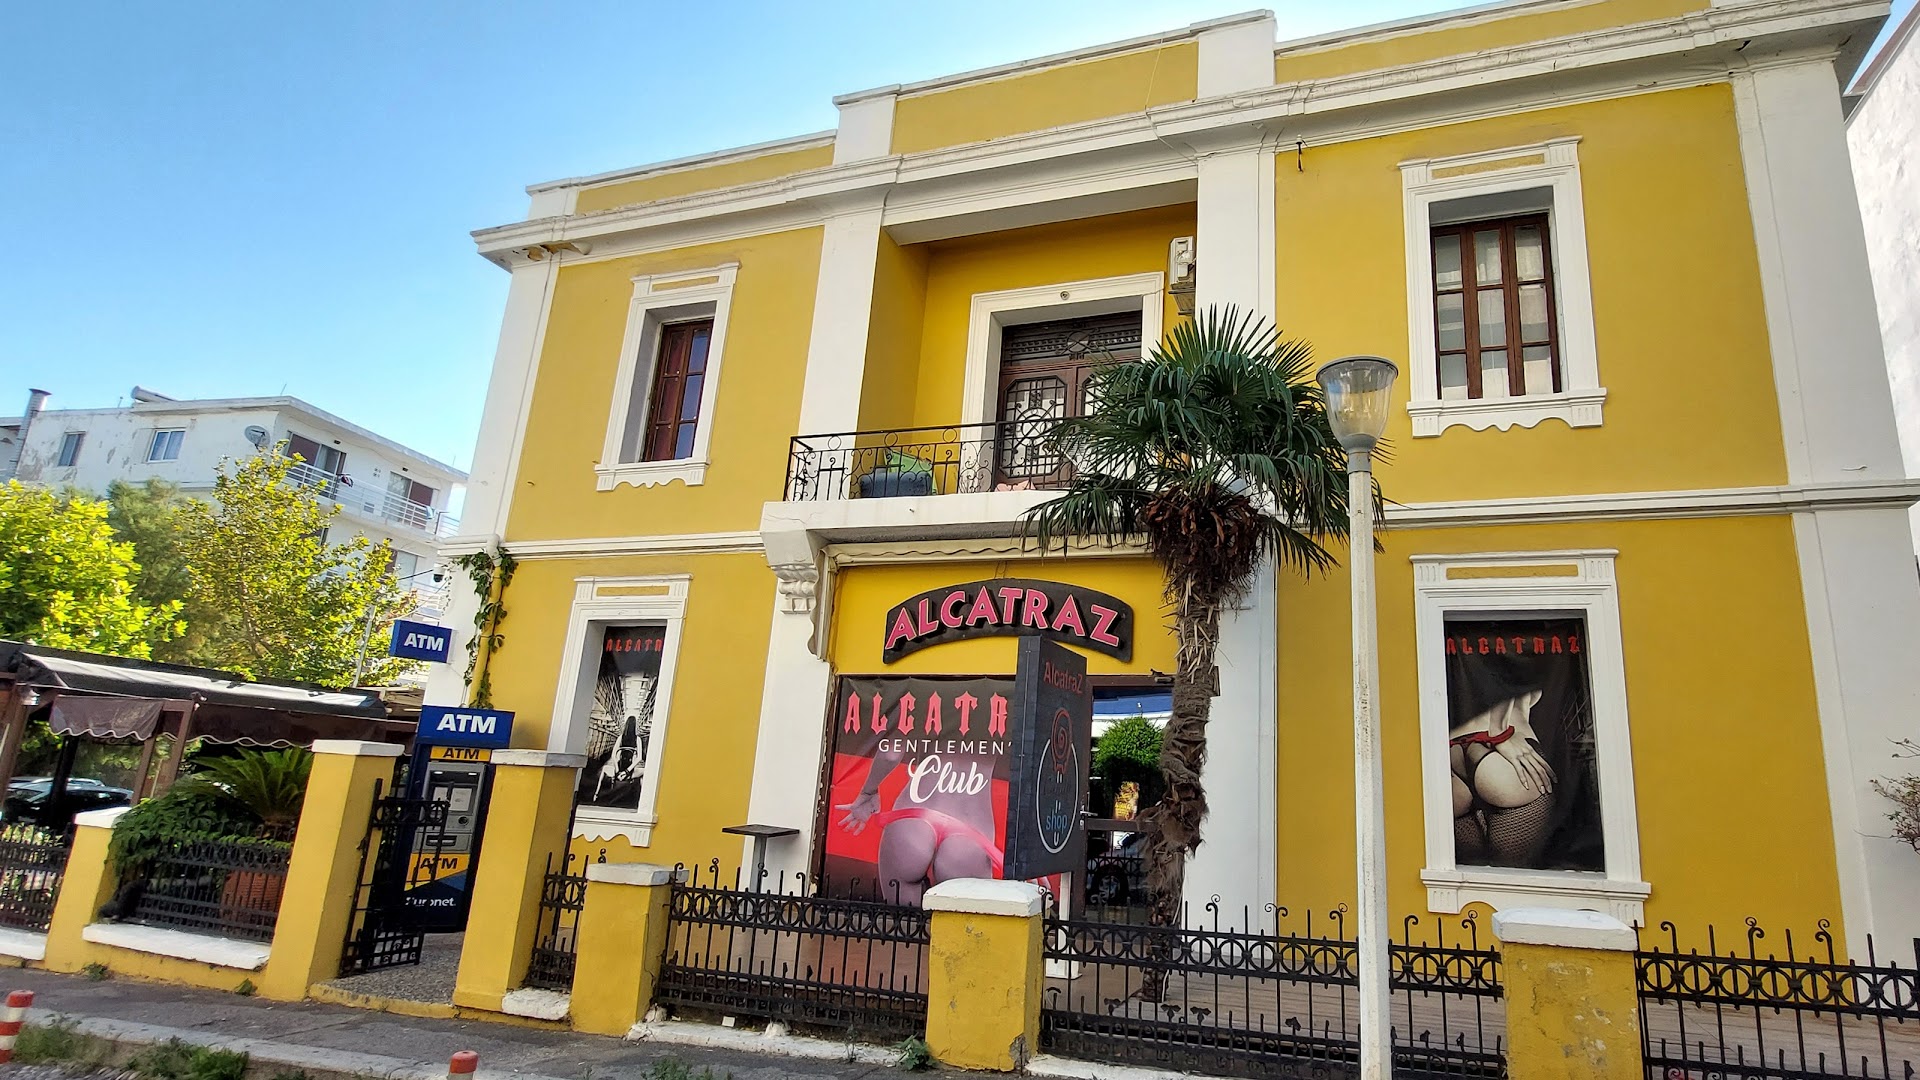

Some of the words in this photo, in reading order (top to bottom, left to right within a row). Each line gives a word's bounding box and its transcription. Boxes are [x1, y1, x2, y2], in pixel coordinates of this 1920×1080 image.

[885, 586, 1120, 650] ALCATRAZ
[404, 633, 444, 651] ATM
[1446, 635, 1580, 655] ALCATRAZ
[436, 713, 497, 734] ATM
[443, 747, 480, 760] ATM
[908, 754, 989, 804] Club
[1045, 808, 1068, 834] shop
